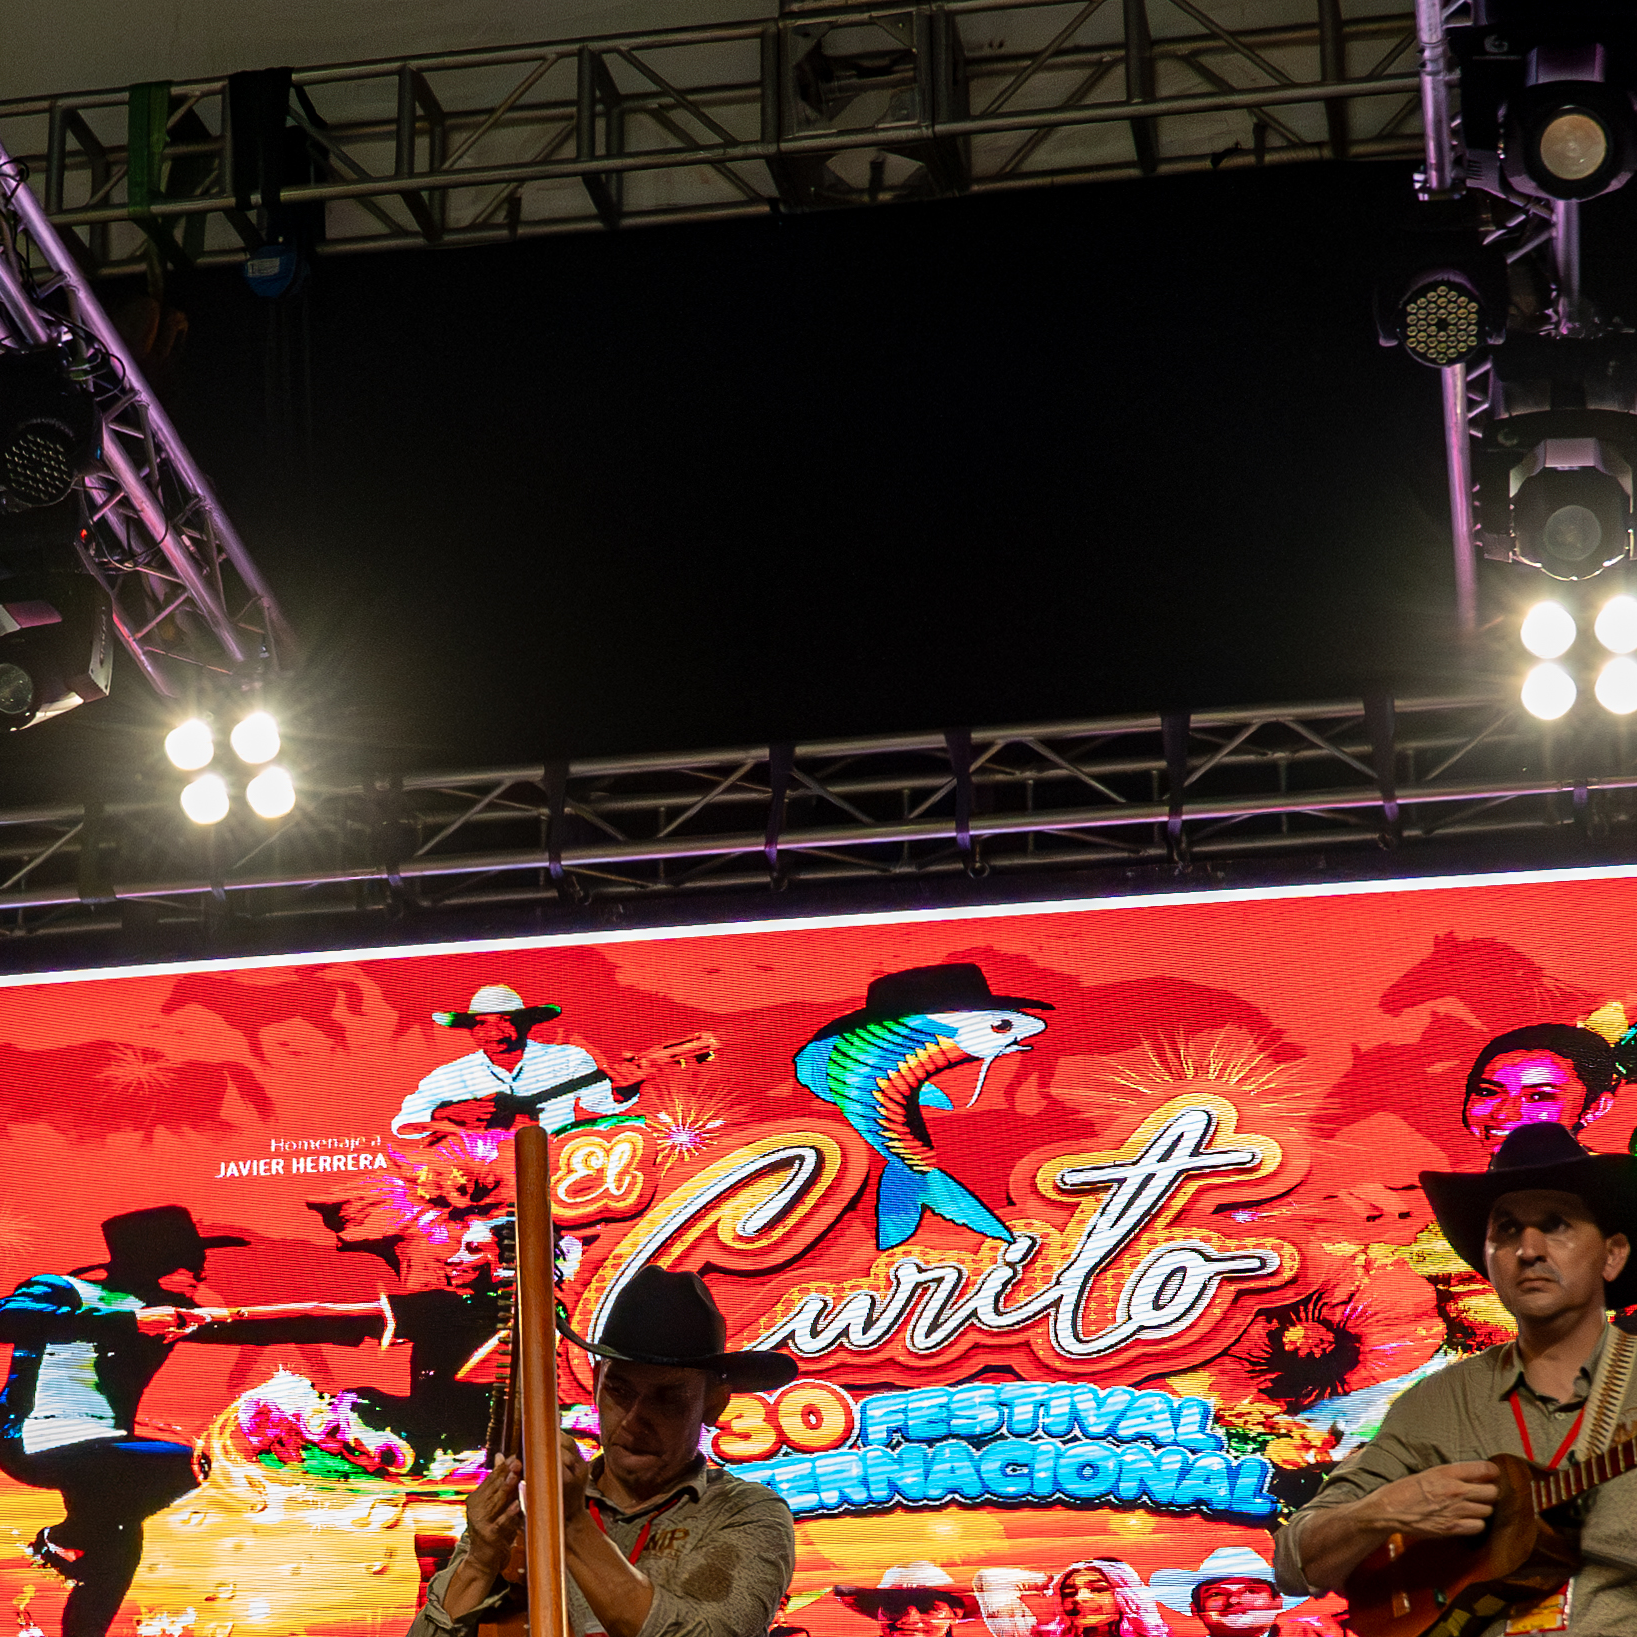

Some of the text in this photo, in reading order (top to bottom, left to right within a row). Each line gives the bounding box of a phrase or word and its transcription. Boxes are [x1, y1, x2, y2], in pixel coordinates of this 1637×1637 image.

[214, 1152, 388, 1178] JAVIER HERRERA
[553, 1138, 637, 1208] El
[585, 1106, 1281, 1360] Curito
[711, 1381, 1228, 1464] 30 FESTIVAL
[725, 1440, 1278, 1517] ERNACIONAL
